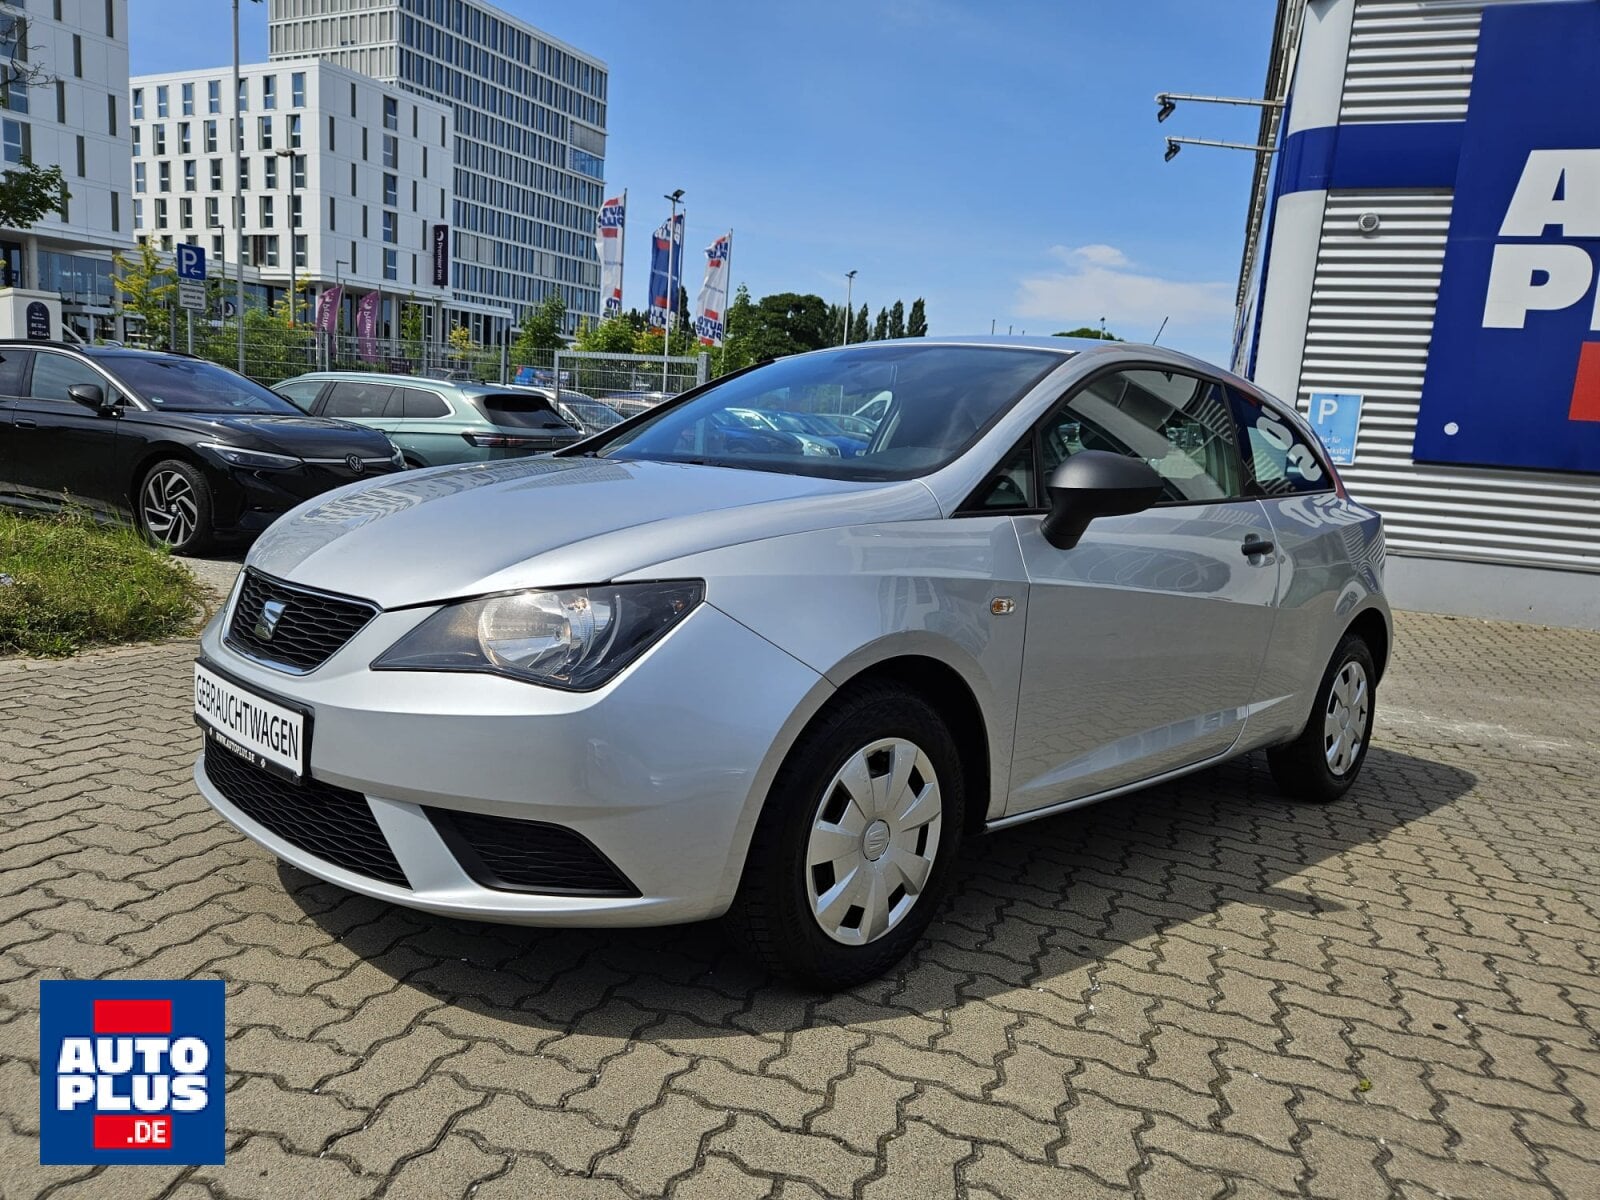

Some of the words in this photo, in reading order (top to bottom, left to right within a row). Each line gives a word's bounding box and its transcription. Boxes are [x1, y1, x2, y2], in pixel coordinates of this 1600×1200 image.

[182, 248, 197, 274] P
[1482, 244, 1600, 331] P
[1317, 398, 1338, 425] P
[197, 674, 298, 760] GEBRAUCHTWAGEN
